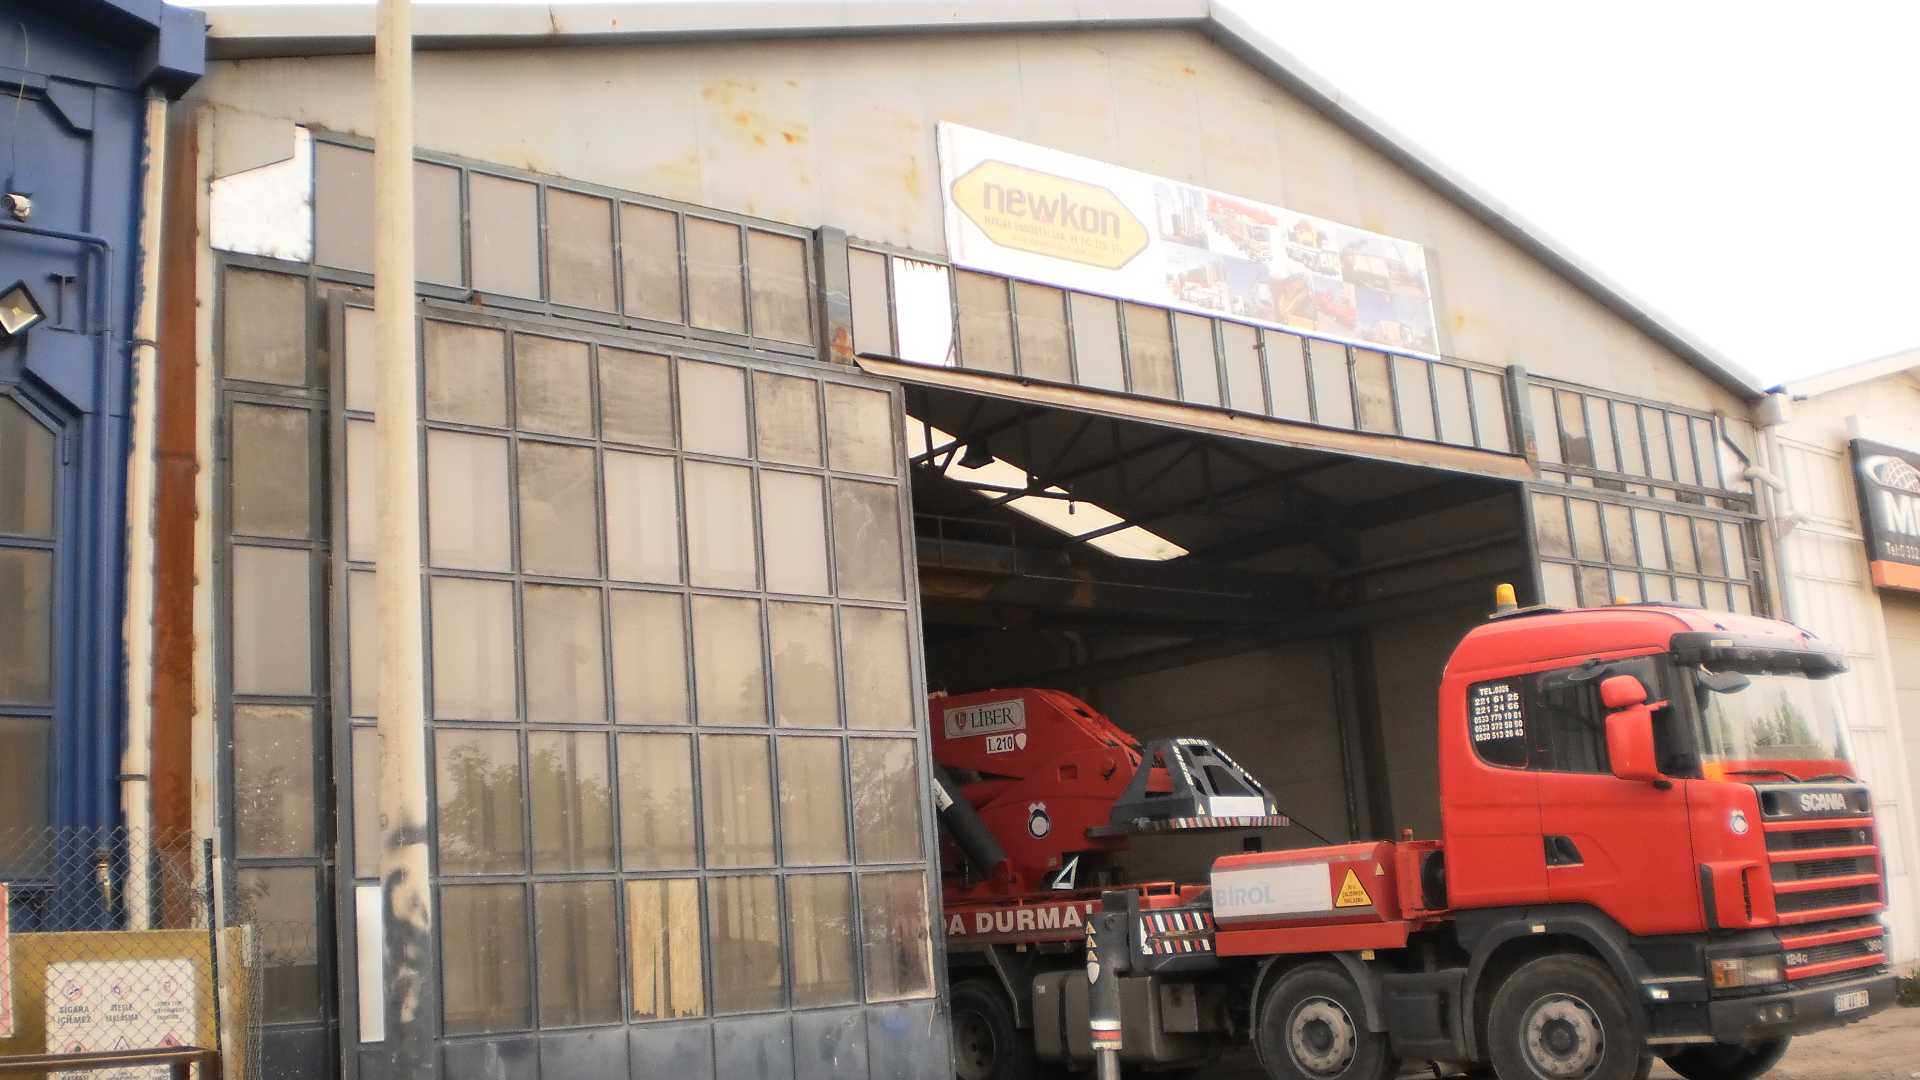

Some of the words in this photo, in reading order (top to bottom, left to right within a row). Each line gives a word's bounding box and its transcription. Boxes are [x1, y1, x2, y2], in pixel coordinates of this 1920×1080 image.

[984, 182, 1120, 239] newkon
[1475, 698, 1490, 706] 221
[1493, 695, 1504, 703] 61
[1507, 693, 1519, 701] 25
[1475, 706, 1490, 715] 221
[1800, 793, 1846, 811] SCANIA
[944, 913, 967, 936] A
